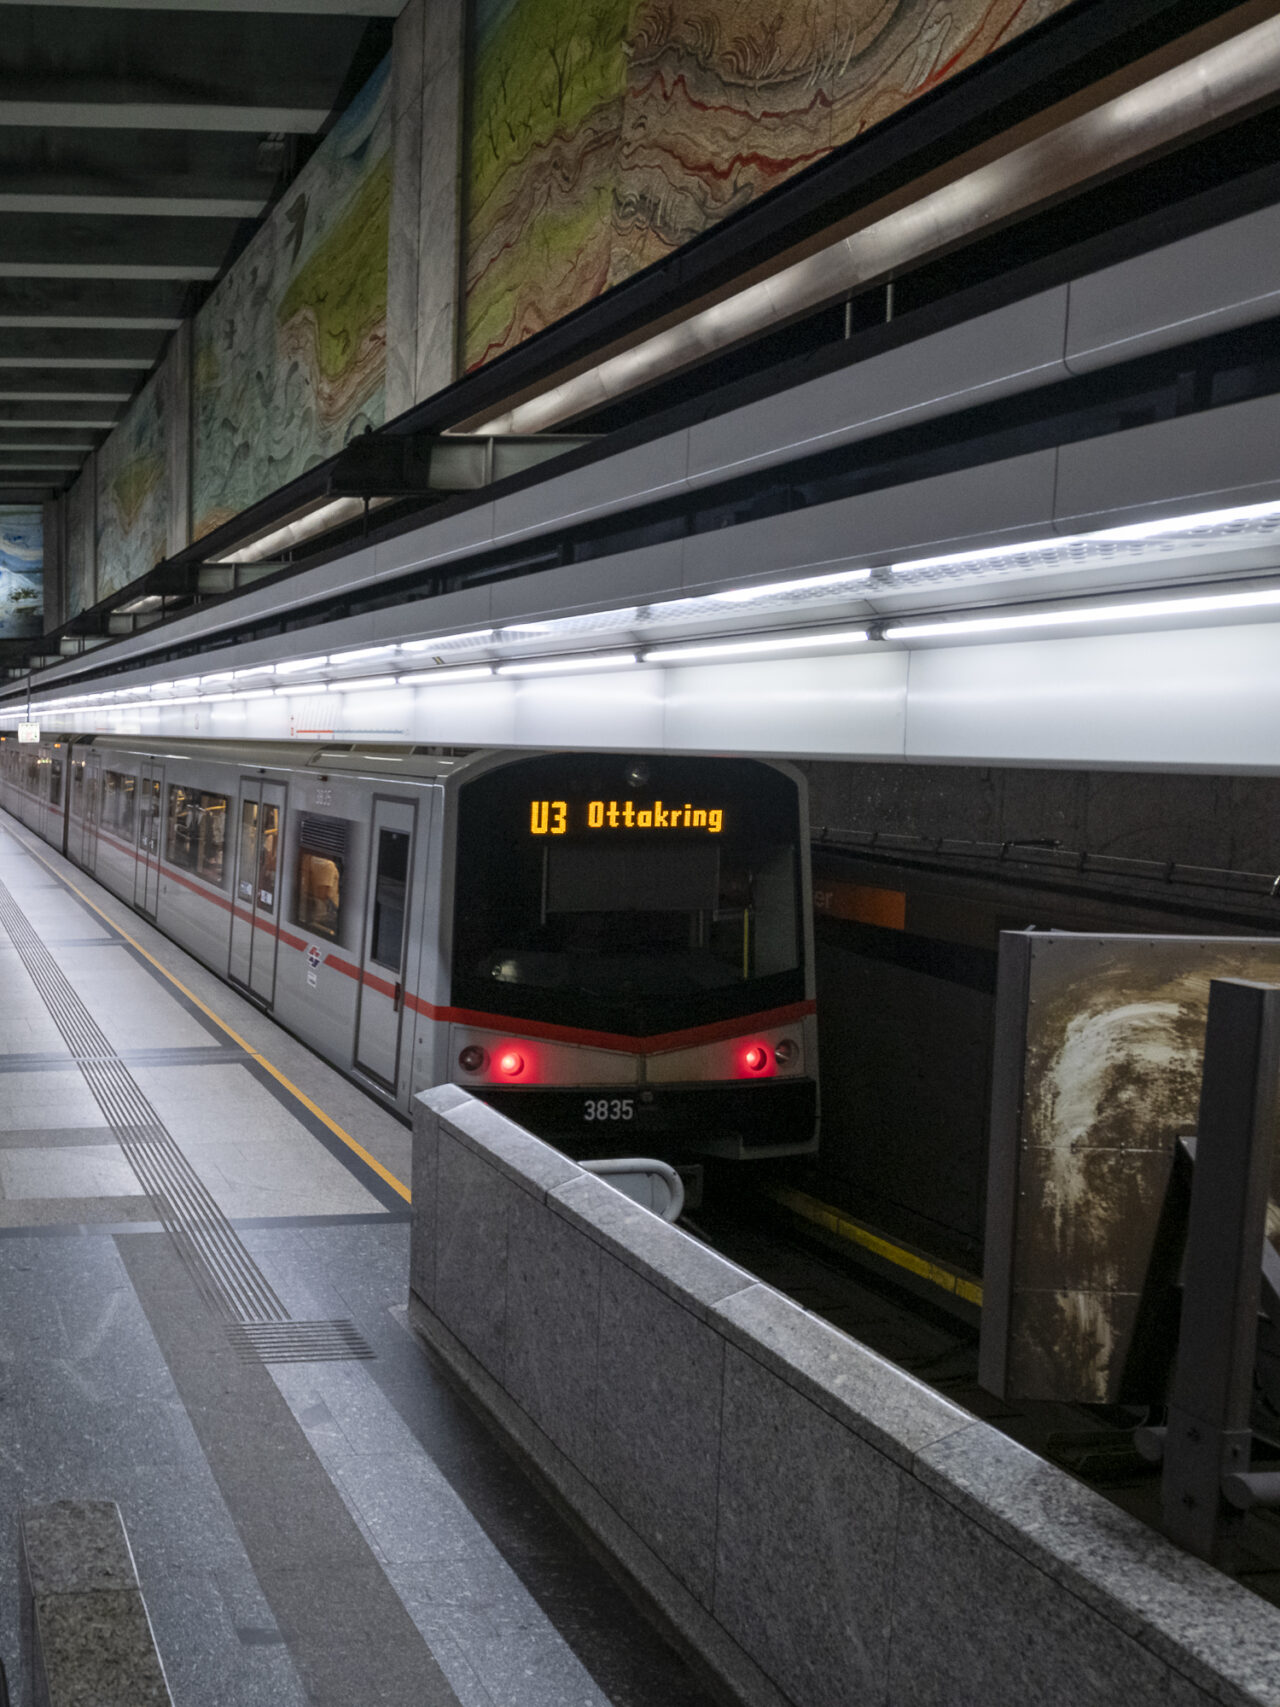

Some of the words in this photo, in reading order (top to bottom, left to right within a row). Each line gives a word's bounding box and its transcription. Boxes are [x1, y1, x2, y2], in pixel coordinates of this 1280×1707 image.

[530, 801, 568, 834] U3
[587, 801, 723, 833] Ottakring
[584, 1100, 634, 1120] 3835
